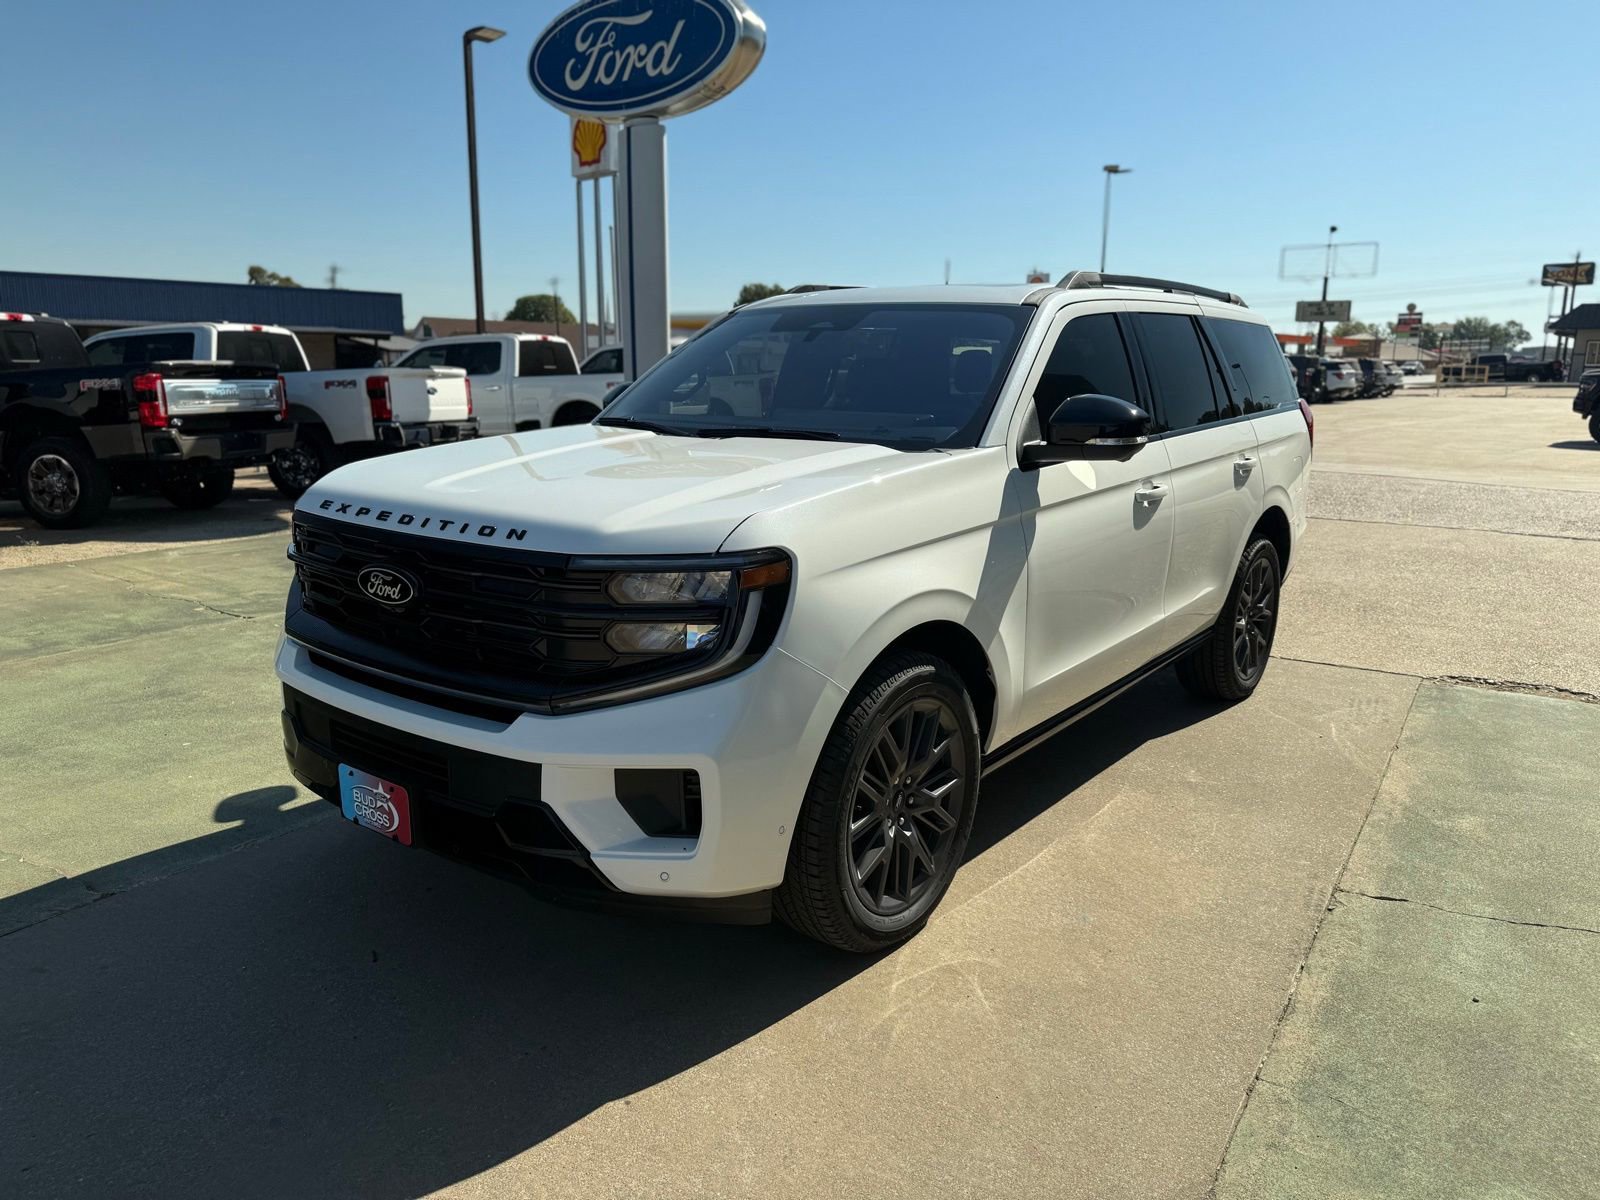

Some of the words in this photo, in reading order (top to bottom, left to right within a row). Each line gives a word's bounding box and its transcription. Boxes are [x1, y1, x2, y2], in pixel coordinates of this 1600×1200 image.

[564, 10, 686, 91] Ford
[1547, 268, 1587, 281] SONC
[80, 378, 121, 392] FX4
[324, 379, 357, 390] FX4
[319, 499, 529, 541] EXPEDITION
[367, 571, 401, 600] Ford
[353, 789, 376, 808] BUD
[354, 802, 390, 827] CROSS
